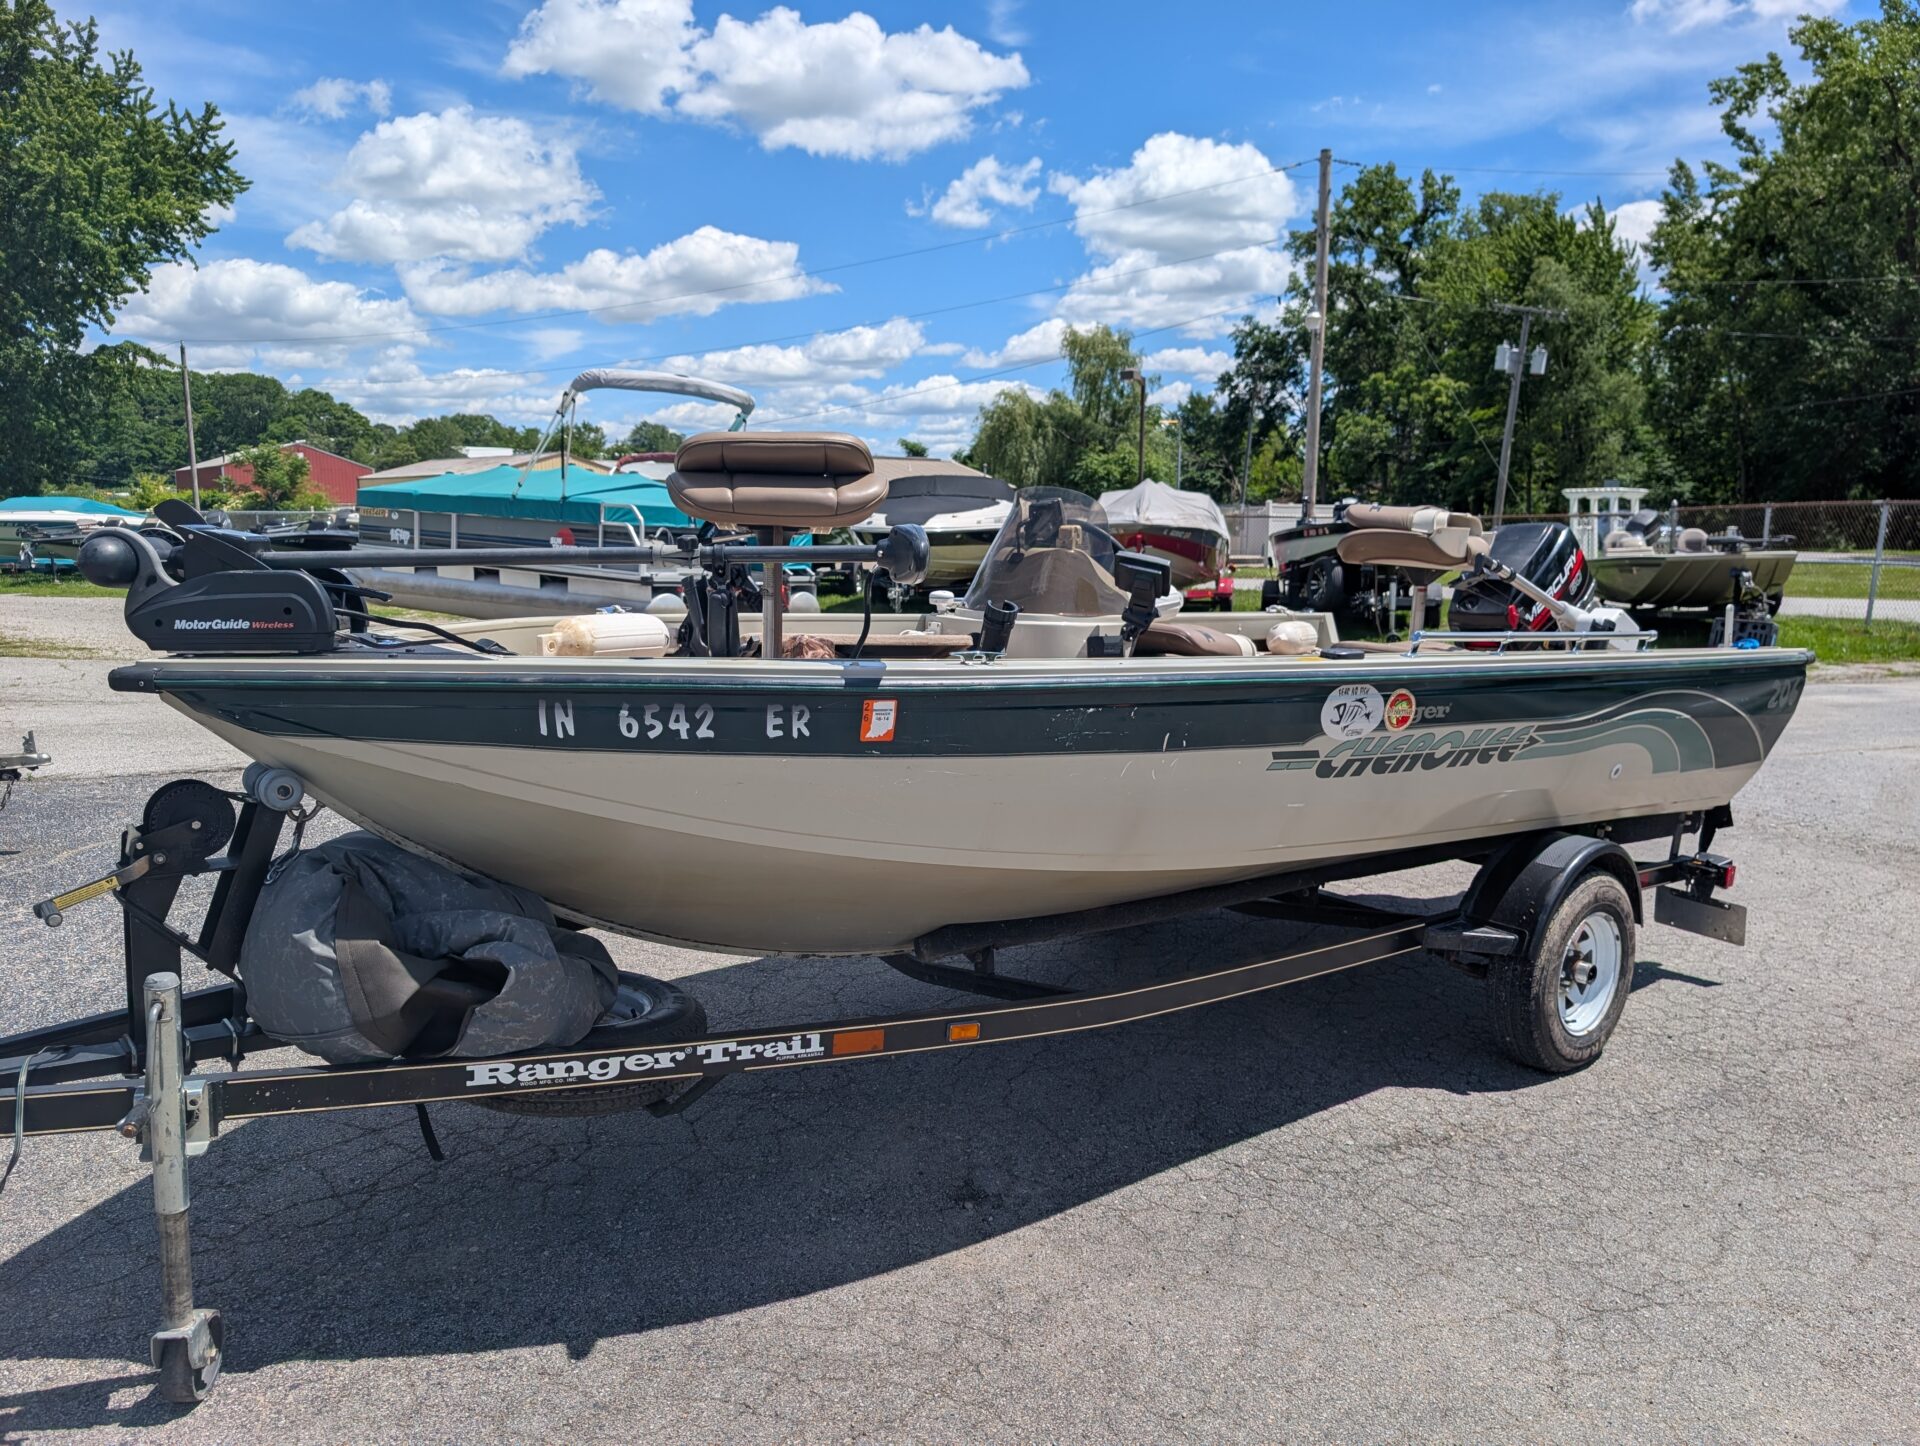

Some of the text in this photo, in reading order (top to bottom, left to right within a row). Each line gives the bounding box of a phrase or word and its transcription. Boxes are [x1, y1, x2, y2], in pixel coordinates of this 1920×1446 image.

[174, 619, 295, 630] MotorGuide Wireless
[538, 699, 811, 740] IN 6542 ER
[1316, 724, 1537, 779] CHEROKEE
[696, 1033, 825, 1064] Trail
